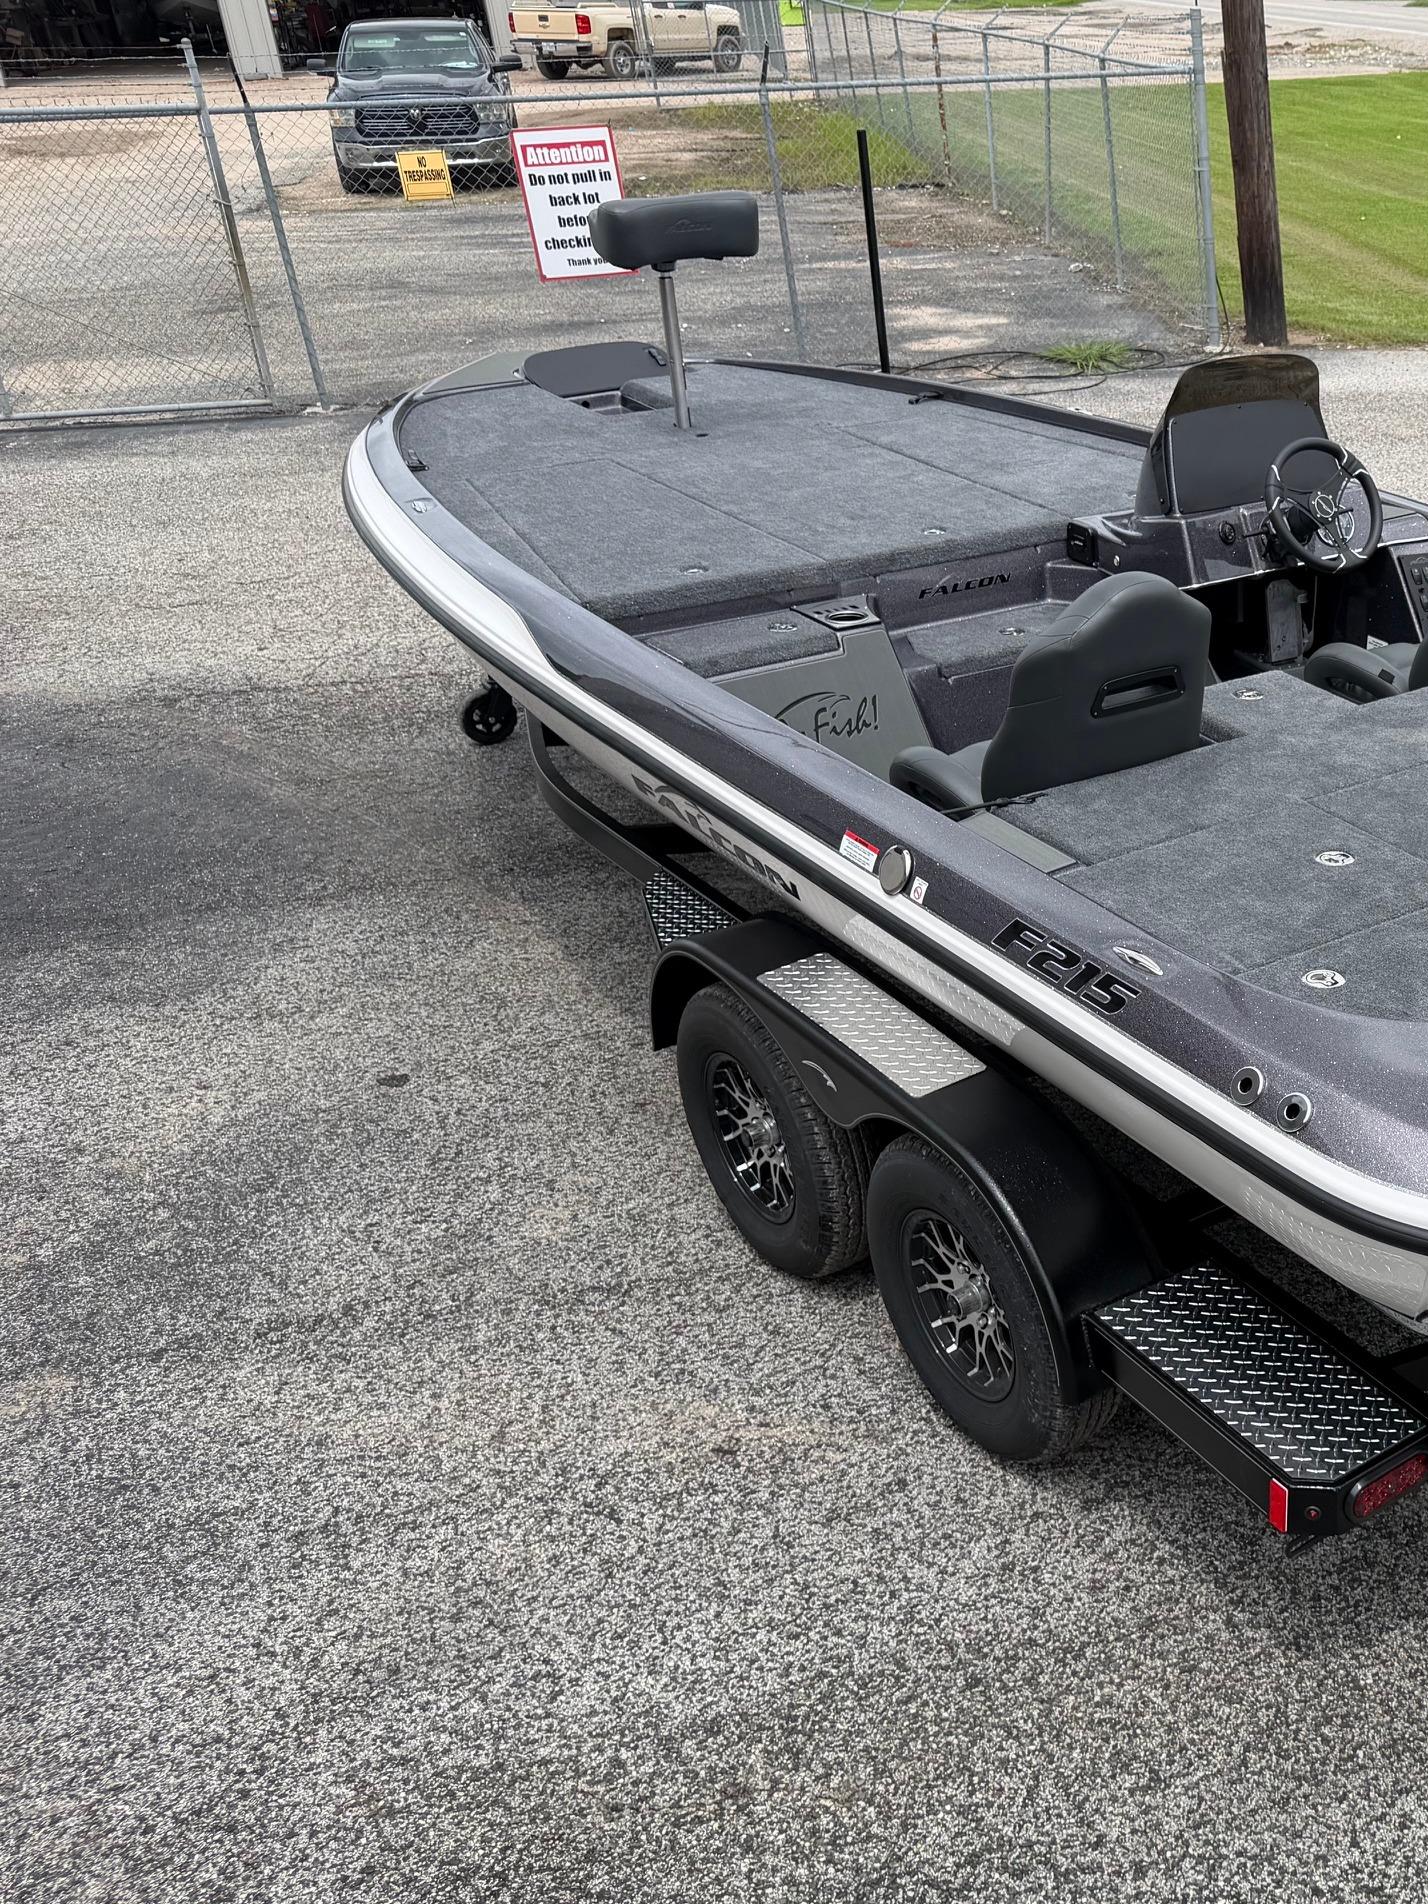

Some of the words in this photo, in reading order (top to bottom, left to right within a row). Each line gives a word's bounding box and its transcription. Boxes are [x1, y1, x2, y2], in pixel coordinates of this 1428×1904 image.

[416, 155, 427, 168] NO
[526, 143, 606, 166] Attention
[403, 168, 446, 182] TRESPASSING
[528, 173, 546, 187] Do
[549, 171, 570, 186] not
[572, 169, 597, 186] pull
[599, 168, 612, 182] in
[549, 193, 582, 207] back
[582, 191, 601, 205] lot
[557, 214, 589, 228] befo
[544, 235, 592, 251] checki
[567, 257, 592, 267] Thank
[918, 572, 1011, 600] FALCON
[814, 694, 879, 743] Fish!
[631, 774, 802, 902] FALCON
[990, 917, 1143, 1016] F215
